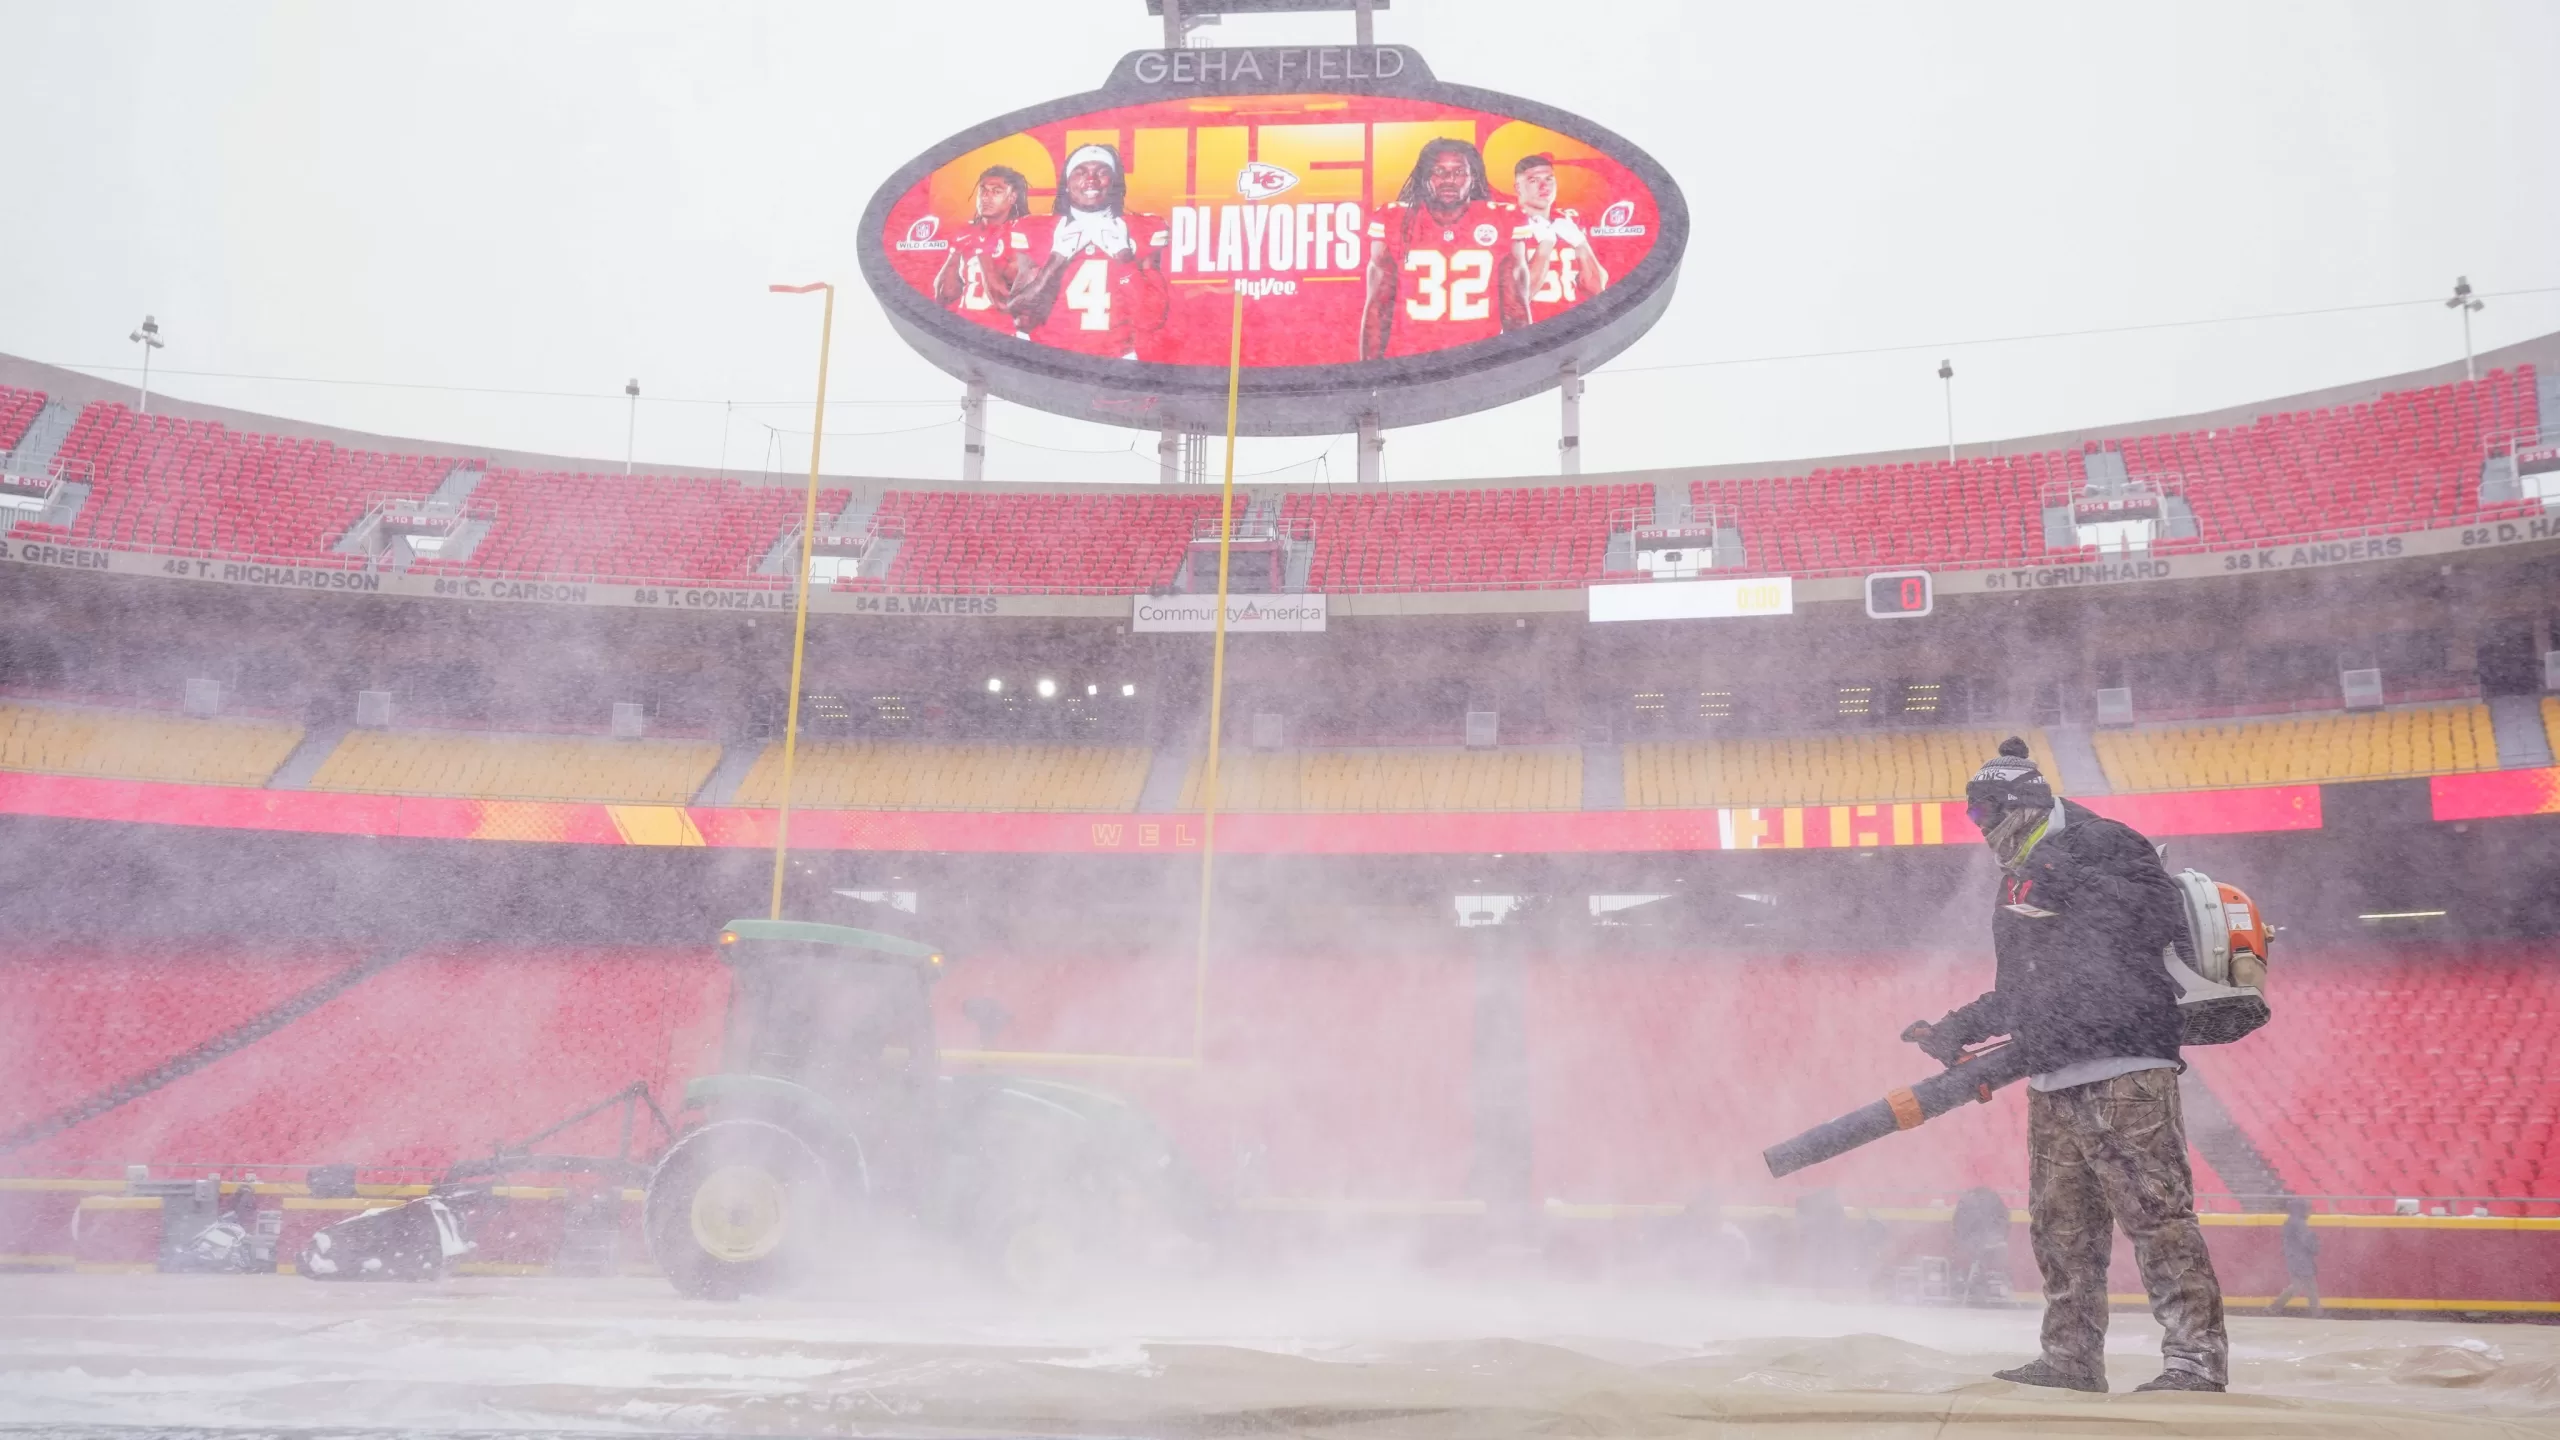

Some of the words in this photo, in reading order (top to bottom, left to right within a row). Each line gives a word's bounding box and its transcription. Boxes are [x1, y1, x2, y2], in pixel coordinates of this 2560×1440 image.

[1134, 50, 1264, 83] GEHA
[1279, 47, 1404, 80] FIELD
[1170, 202, 1361, 272] PLAYOFFS
[1065, 259, 1111, 331] 4
[1404, 249, 1494, 322] 32
[1641, 530, 1663, 538] 313
[1684, 529, 1706, 537] 314
[2462, 528, 2491, 546] 82
[2498, 523, 2523, 541] D.
[22, 543, 109, 569] GREEN
[2224, 553, 2252, 571] 38
[2258, 550, 2282, 568] K.
[2290, 537, 2403, 565] ANDERS
[163, 559, 190, 576] 49
[196, 561, 215, 579] T.
[223, 564, 379, 592] RICHARDSON
[1986, 572, 2006, 588] 61
[2035, 558, 2170, 586] GRUNHARD
[464, 579, 485, 597] C.
[491, 581, 587, 602] CARSON
[665, 588, 679, 606] T.
[1901, 578, 1921, 611] 0
[884, 596, 905, 613] B.
[907, 597, 998, 615] WATERS
[1139, 601, 1320, 623] CommuntyAmerica
[1092, 823, 1196, 846] WEL
